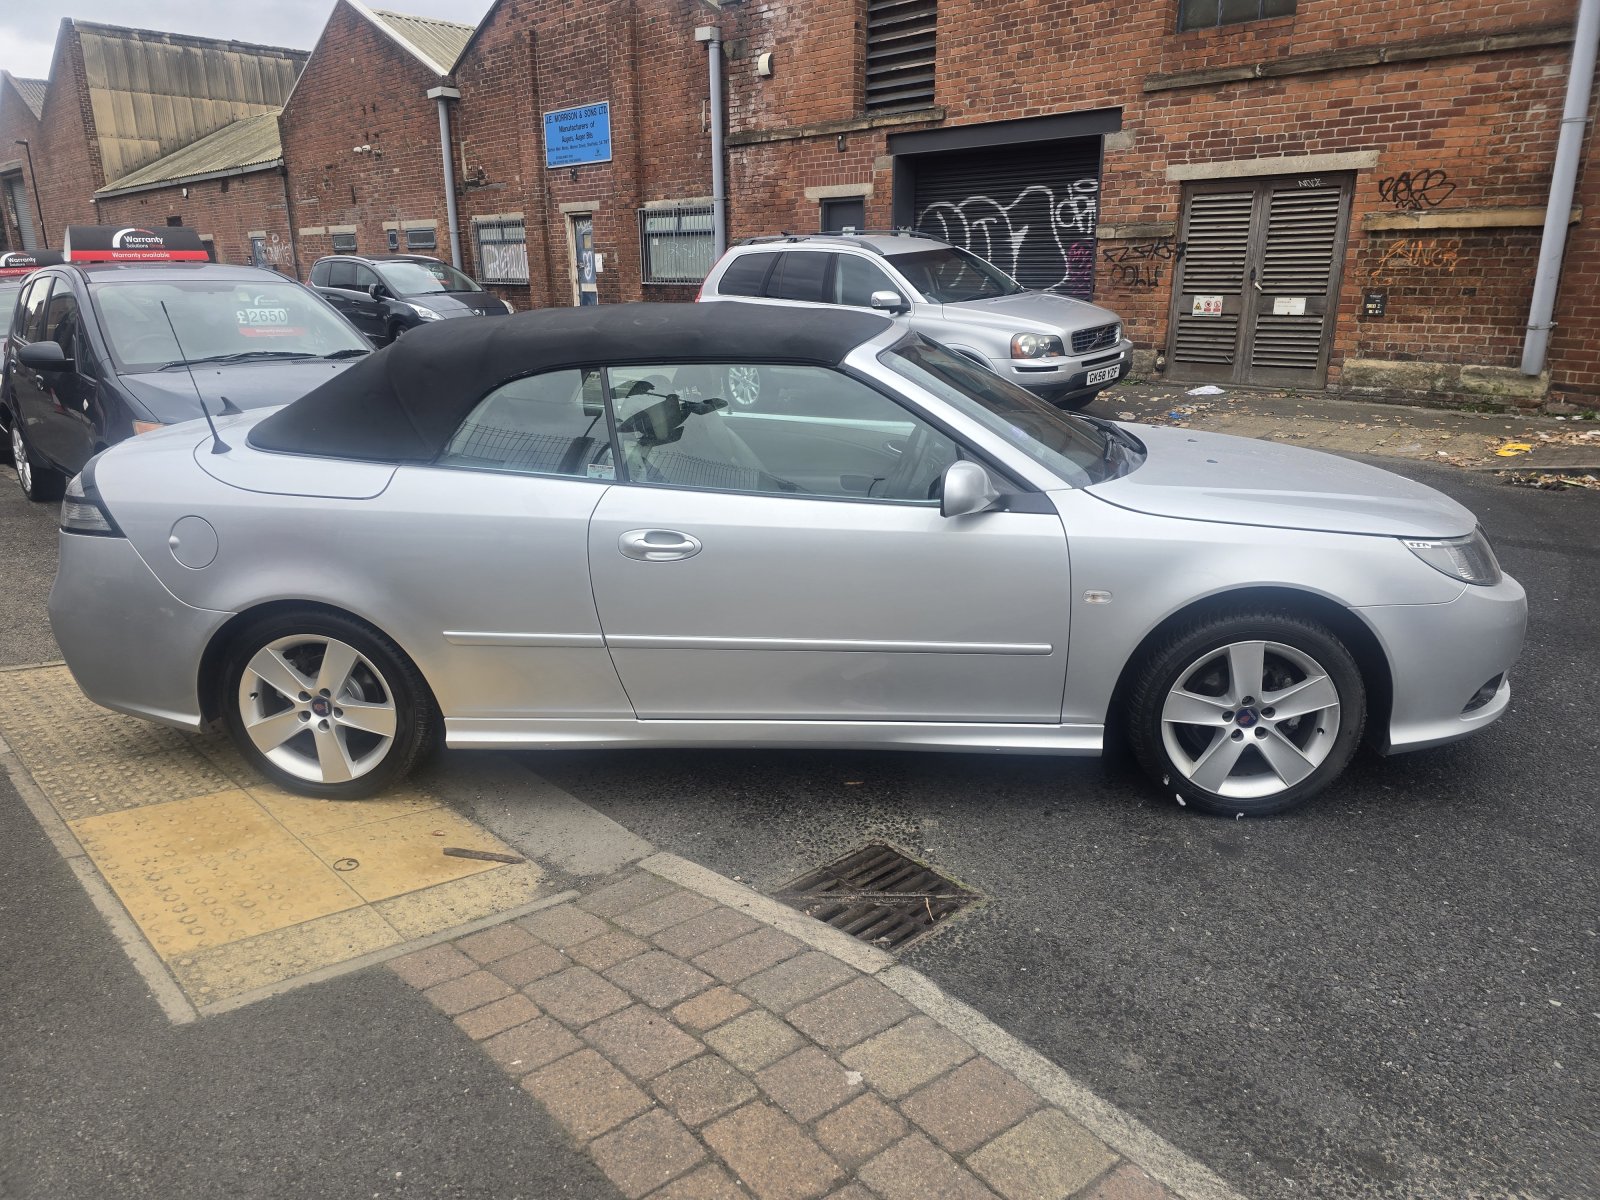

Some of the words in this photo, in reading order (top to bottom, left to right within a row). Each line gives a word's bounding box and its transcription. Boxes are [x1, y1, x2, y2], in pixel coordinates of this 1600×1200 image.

[554, 111, 577, 122] MORRISON
[584, 108, 597, 118] SONS
[559, 124, 588, 132] Manufacturers
[590, 120, 595, 128] of
[124, 235, 163, 245] Warranty
[1089, 371, 1106, 383] GK58
[1108, 367, 1118, 378] YZF
